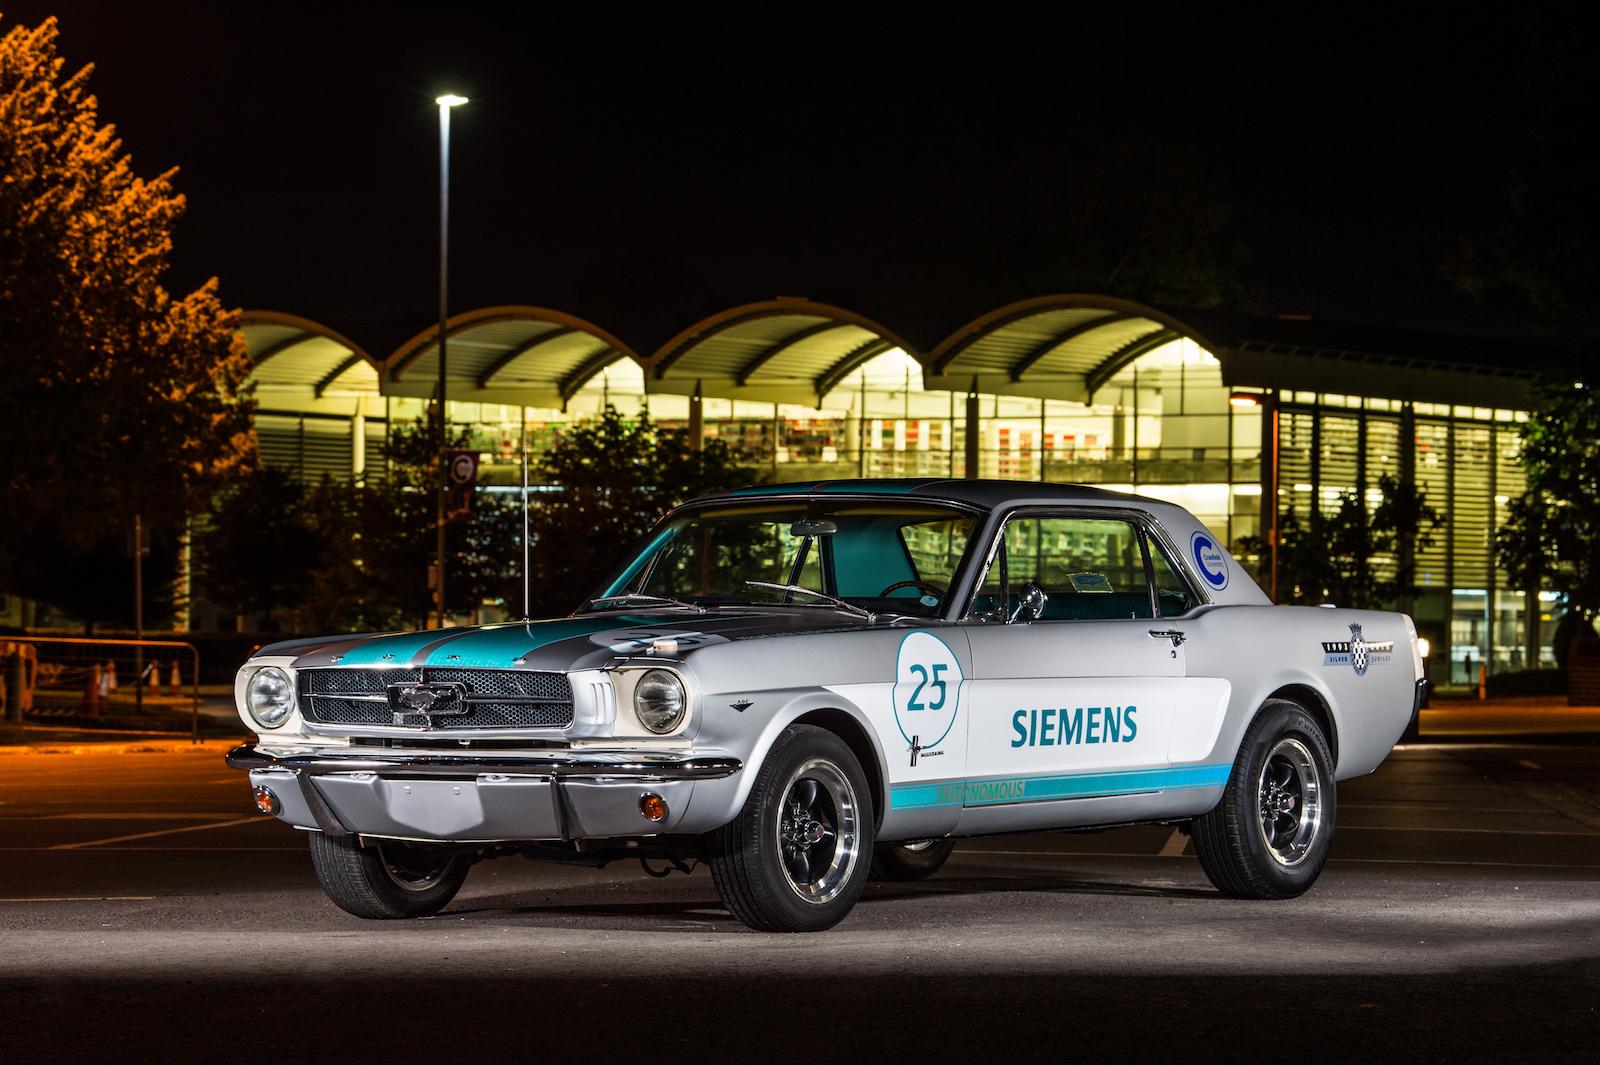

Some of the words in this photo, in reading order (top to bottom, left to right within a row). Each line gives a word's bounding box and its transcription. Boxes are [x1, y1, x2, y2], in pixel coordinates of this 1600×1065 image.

[907, 663, 948, 711] 25
[1011, 705, 1138, 748] SIEMENS
[936, 780, 1025, 803] AUTONOMOUS
